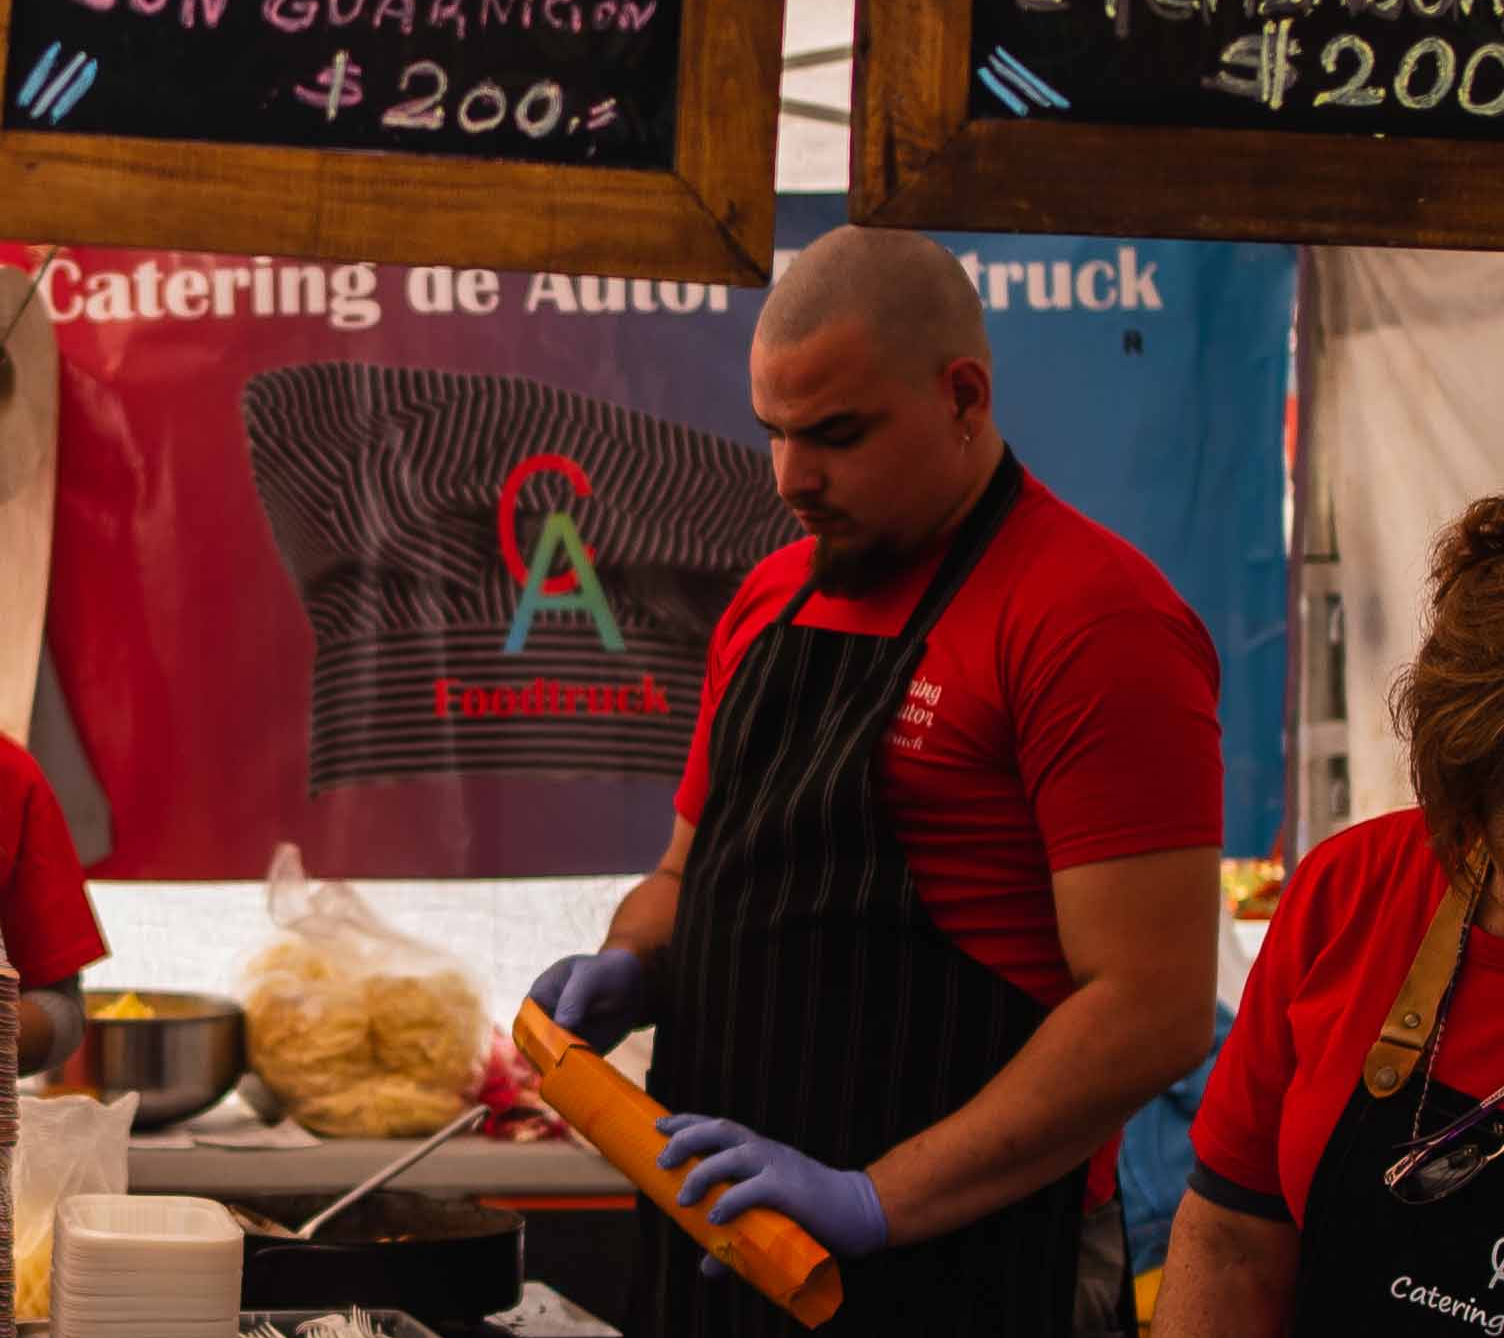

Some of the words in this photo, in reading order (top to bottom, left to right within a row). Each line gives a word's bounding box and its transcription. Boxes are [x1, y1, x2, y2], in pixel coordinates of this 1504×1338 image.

[34, 255, 384, 329] Catering
[408, 265, 500, 313] de
[430, 671, 672, 719] Foodtruck
